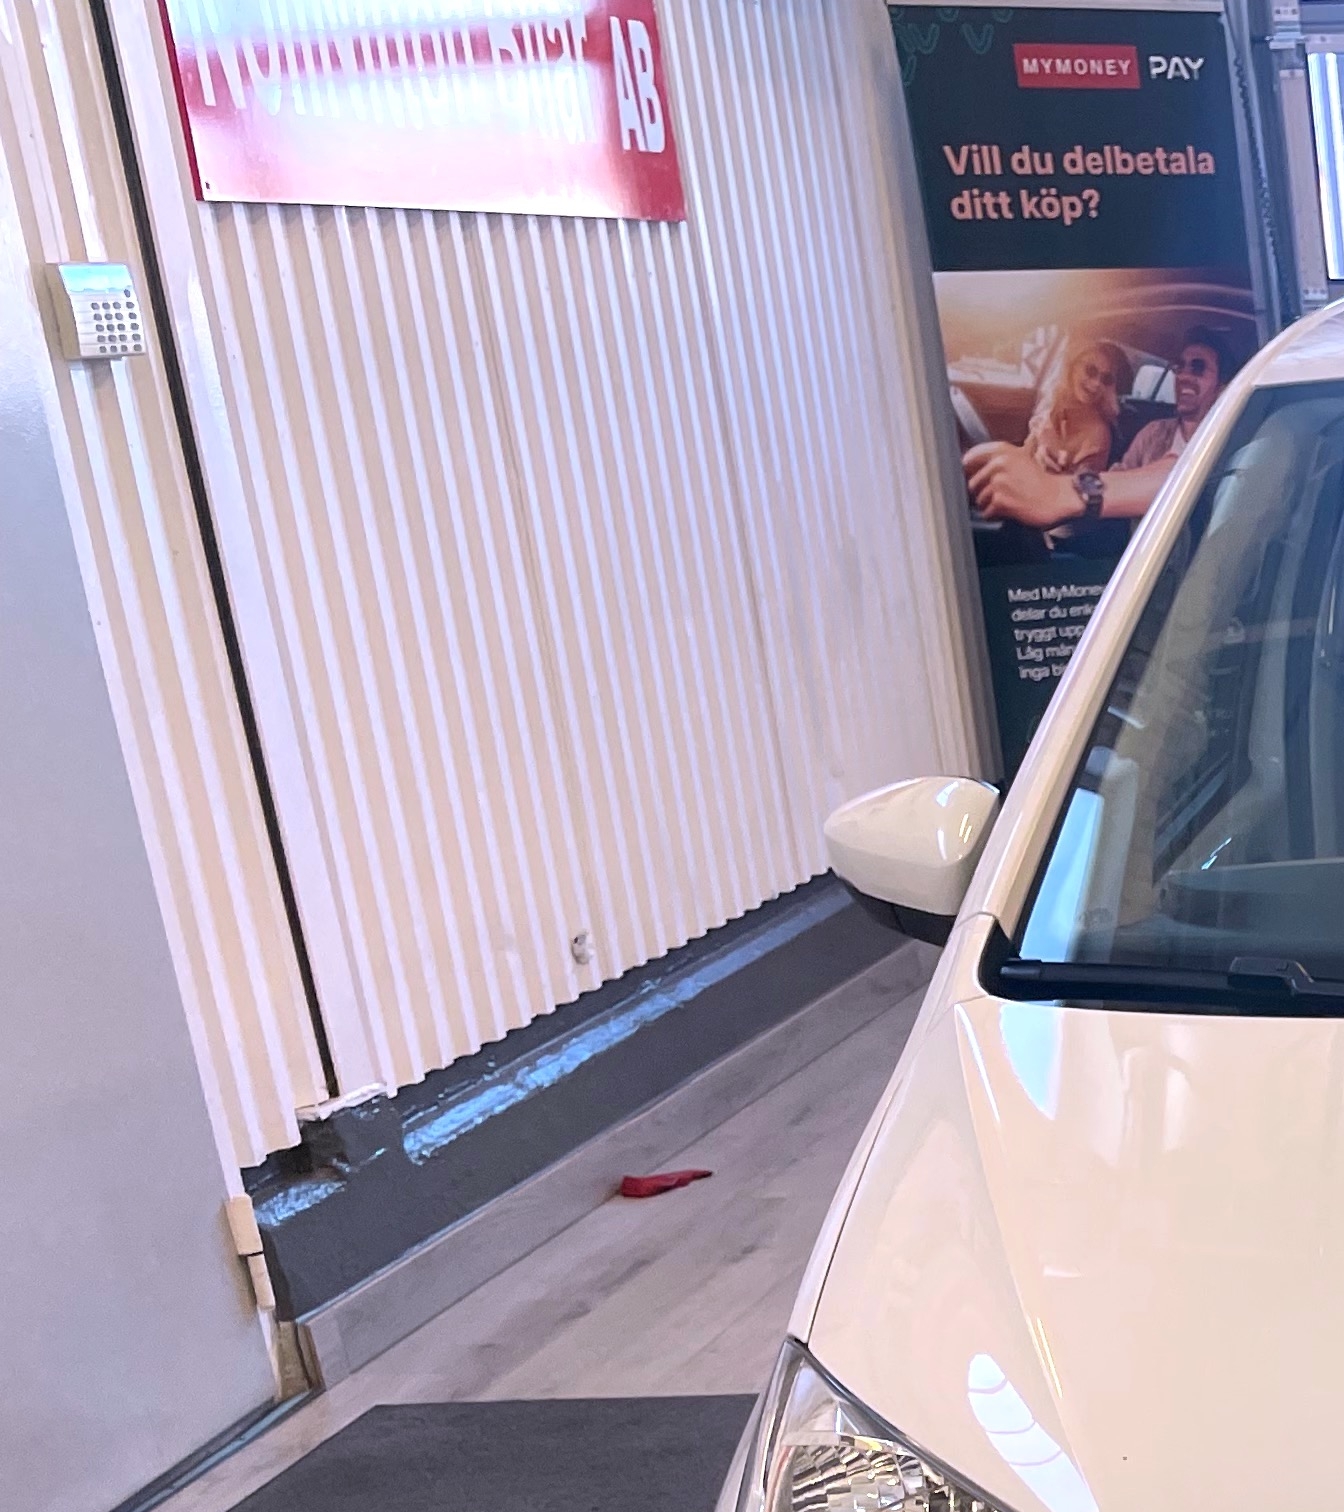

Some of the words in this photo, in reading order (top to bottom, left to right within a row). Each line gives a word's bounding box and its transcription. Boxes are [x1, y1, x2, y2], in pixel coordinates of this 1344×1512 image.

[1022, 57, 1132, 77] MYMONEY
[1148, 55, 1205, 81] PAY
[608, 16, 666, 153] AB
[942, 144, 1001, 176] Vill
[1011, 145, 1054, 176] du
[1062, 145, 1216, 176] delbetala
[950, 188, 1014, 221] ditt
[1021, 188, 1100, 226] köp?
[1047, 604, 1068, 619] du
